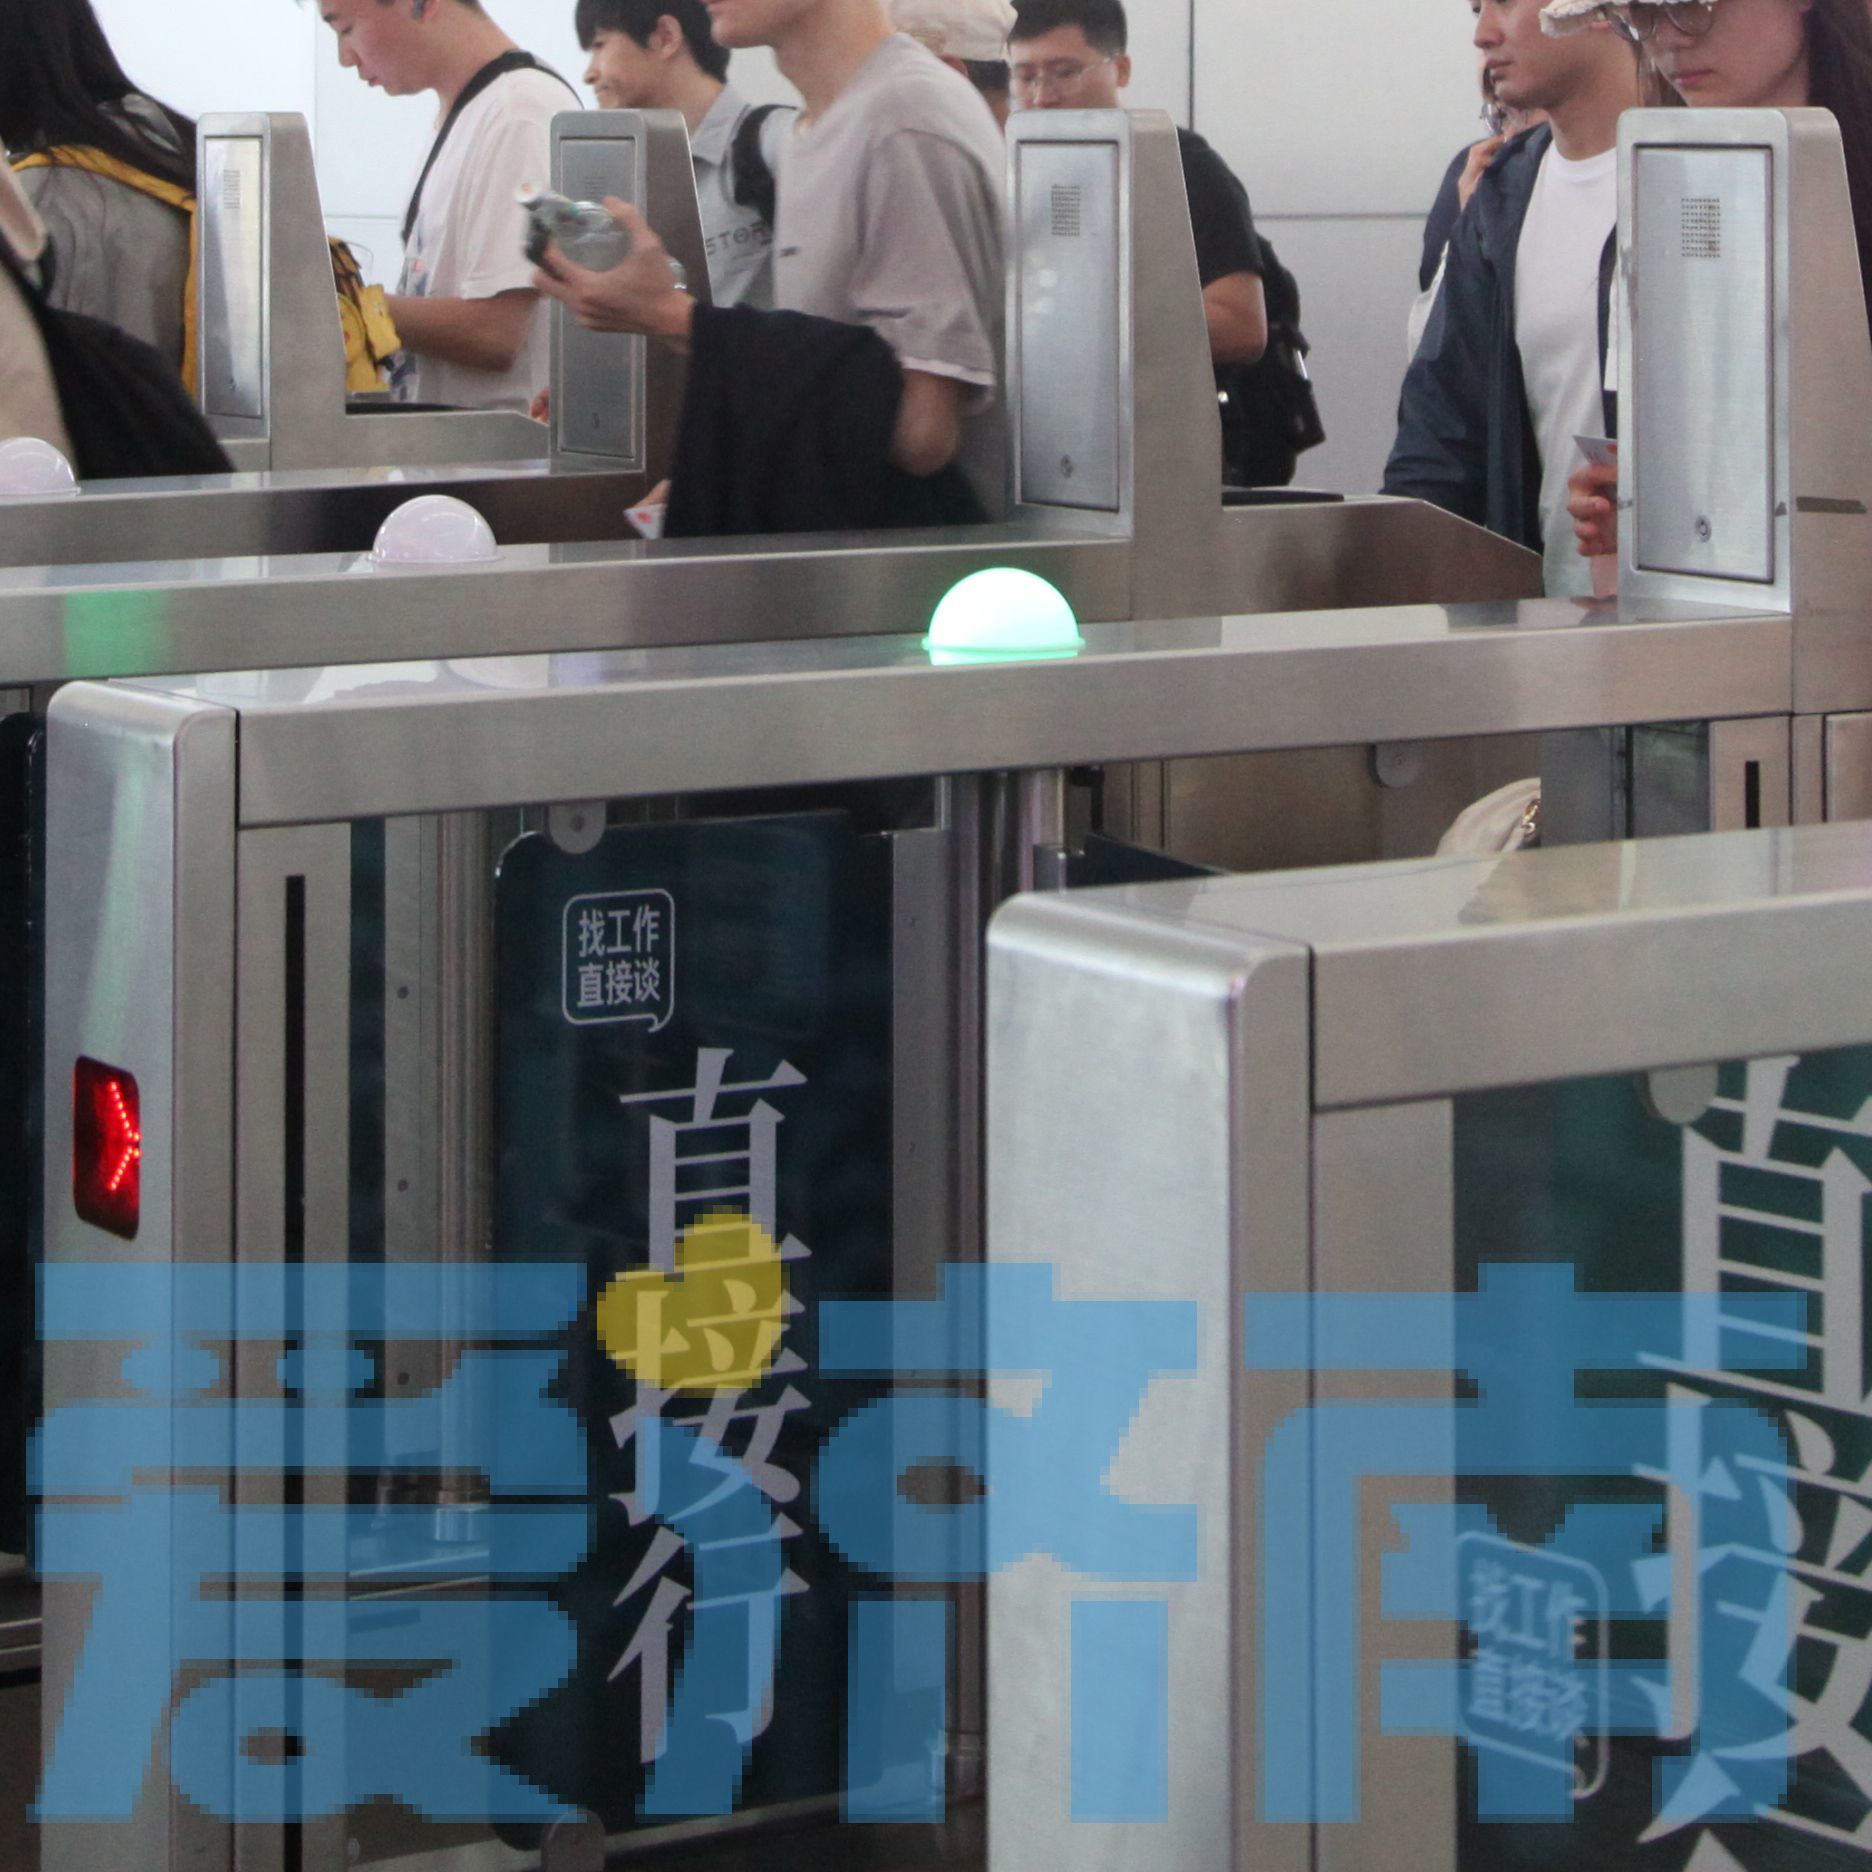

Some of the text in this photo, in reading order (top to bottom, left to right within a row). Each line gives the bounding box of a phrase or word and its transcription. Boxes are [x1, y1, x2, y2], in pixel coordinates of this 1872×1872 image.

[578, 903, 661, 958] 找工作
[576, 957, 661, 1008] 直接谈
[605, 1046, 815, 1766] 直接行
[1469, 1558, 1587, 1659] 找工作
[1468, 1645, 1591, 1747] 直接谈
